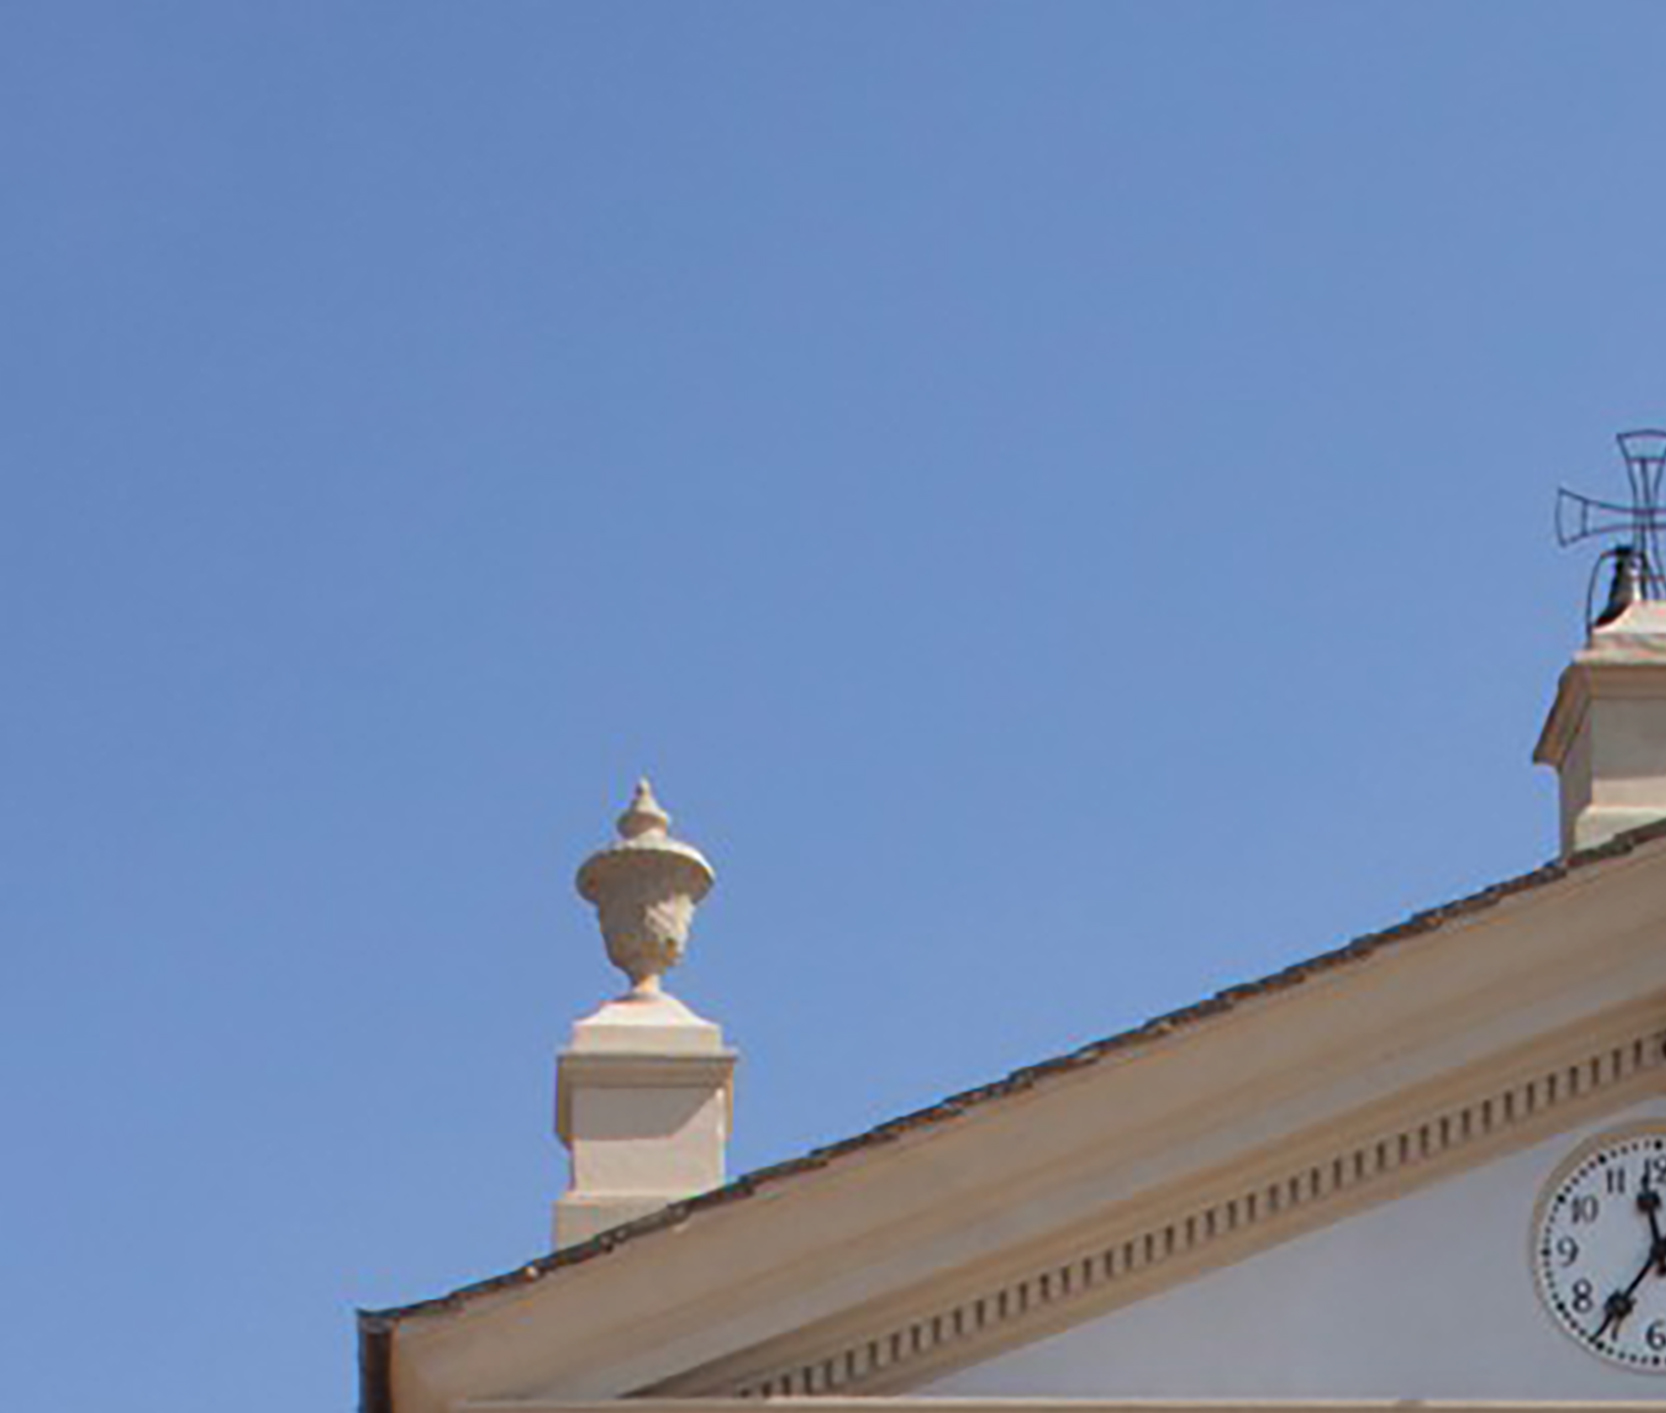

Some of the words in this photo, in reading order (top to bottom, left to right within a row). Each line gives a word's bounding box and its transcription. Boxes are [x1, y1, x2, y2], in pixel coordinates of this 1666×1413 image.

[1606, 1167, 1625, 1194] 11
[1571, 1196, 1599, 1224] 10
[1556, 1236, 1580, 1268] 9
[1571, 1279, 1593, 1314] 8
